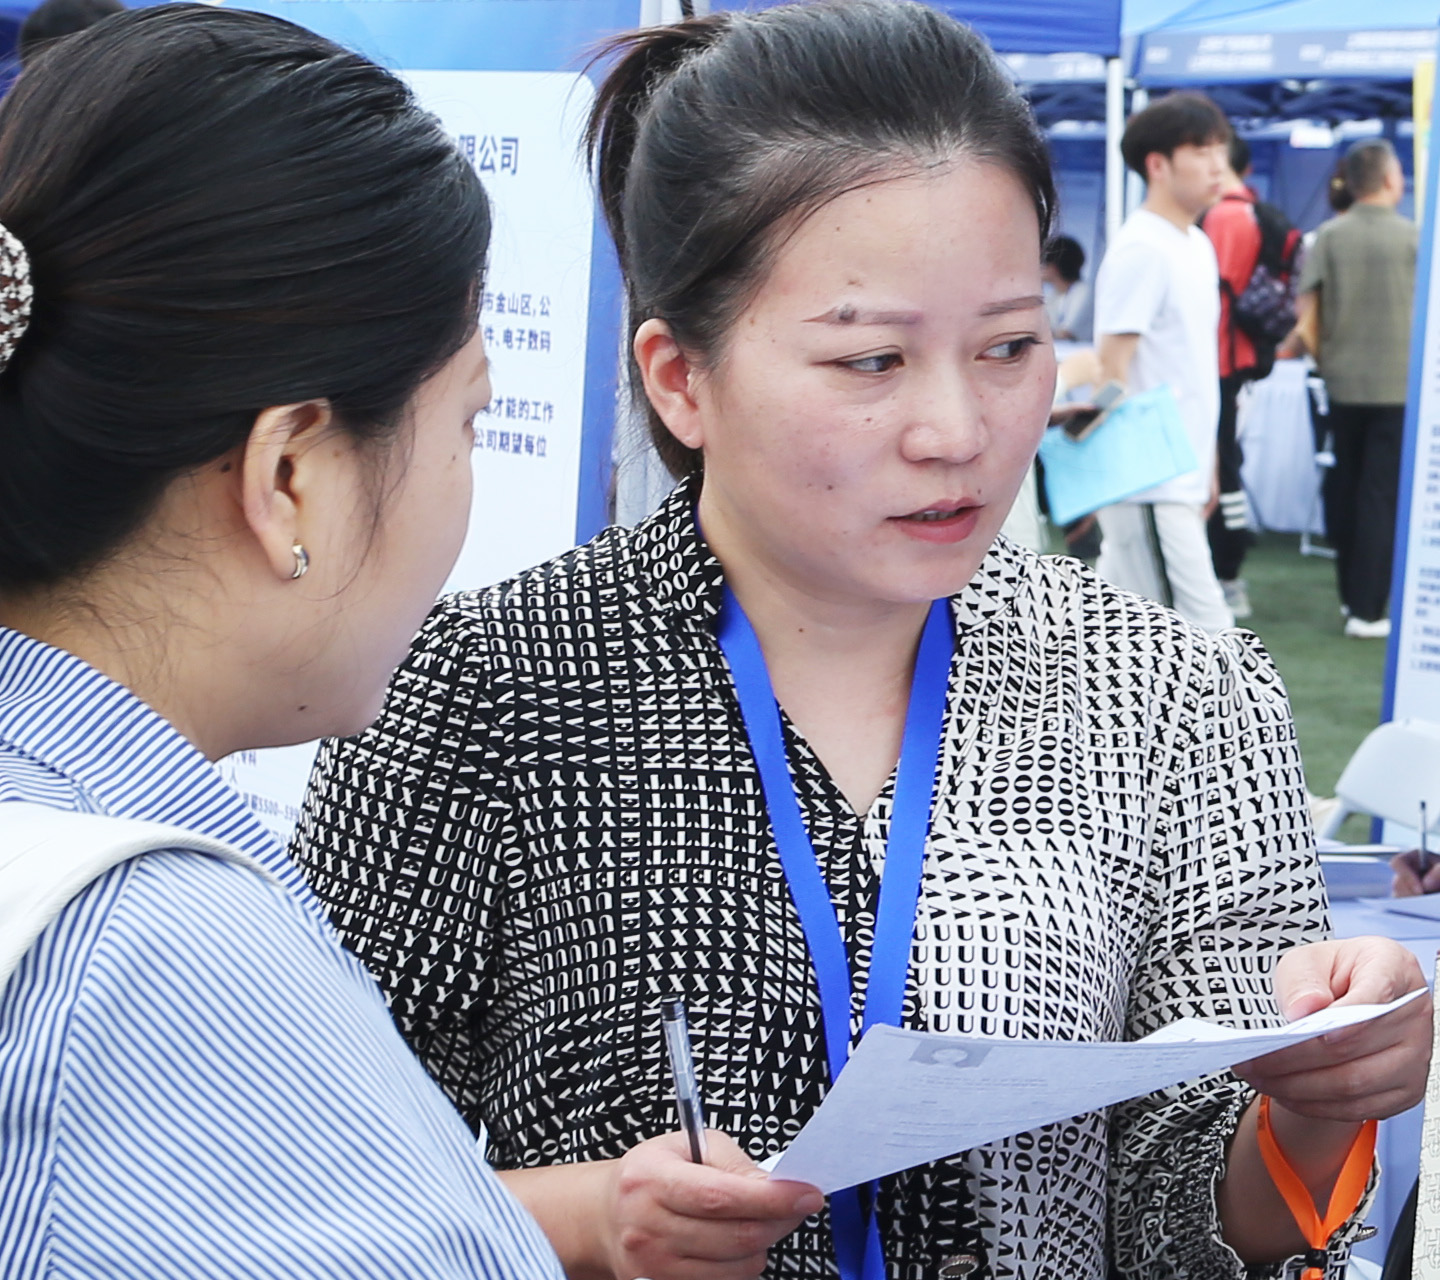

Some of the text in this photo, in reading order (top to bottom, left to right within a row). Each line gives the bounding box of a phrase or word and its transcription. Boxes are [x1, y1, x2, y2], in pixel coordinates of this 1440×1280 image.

[486, 395, 555, 425] 才能的工作
